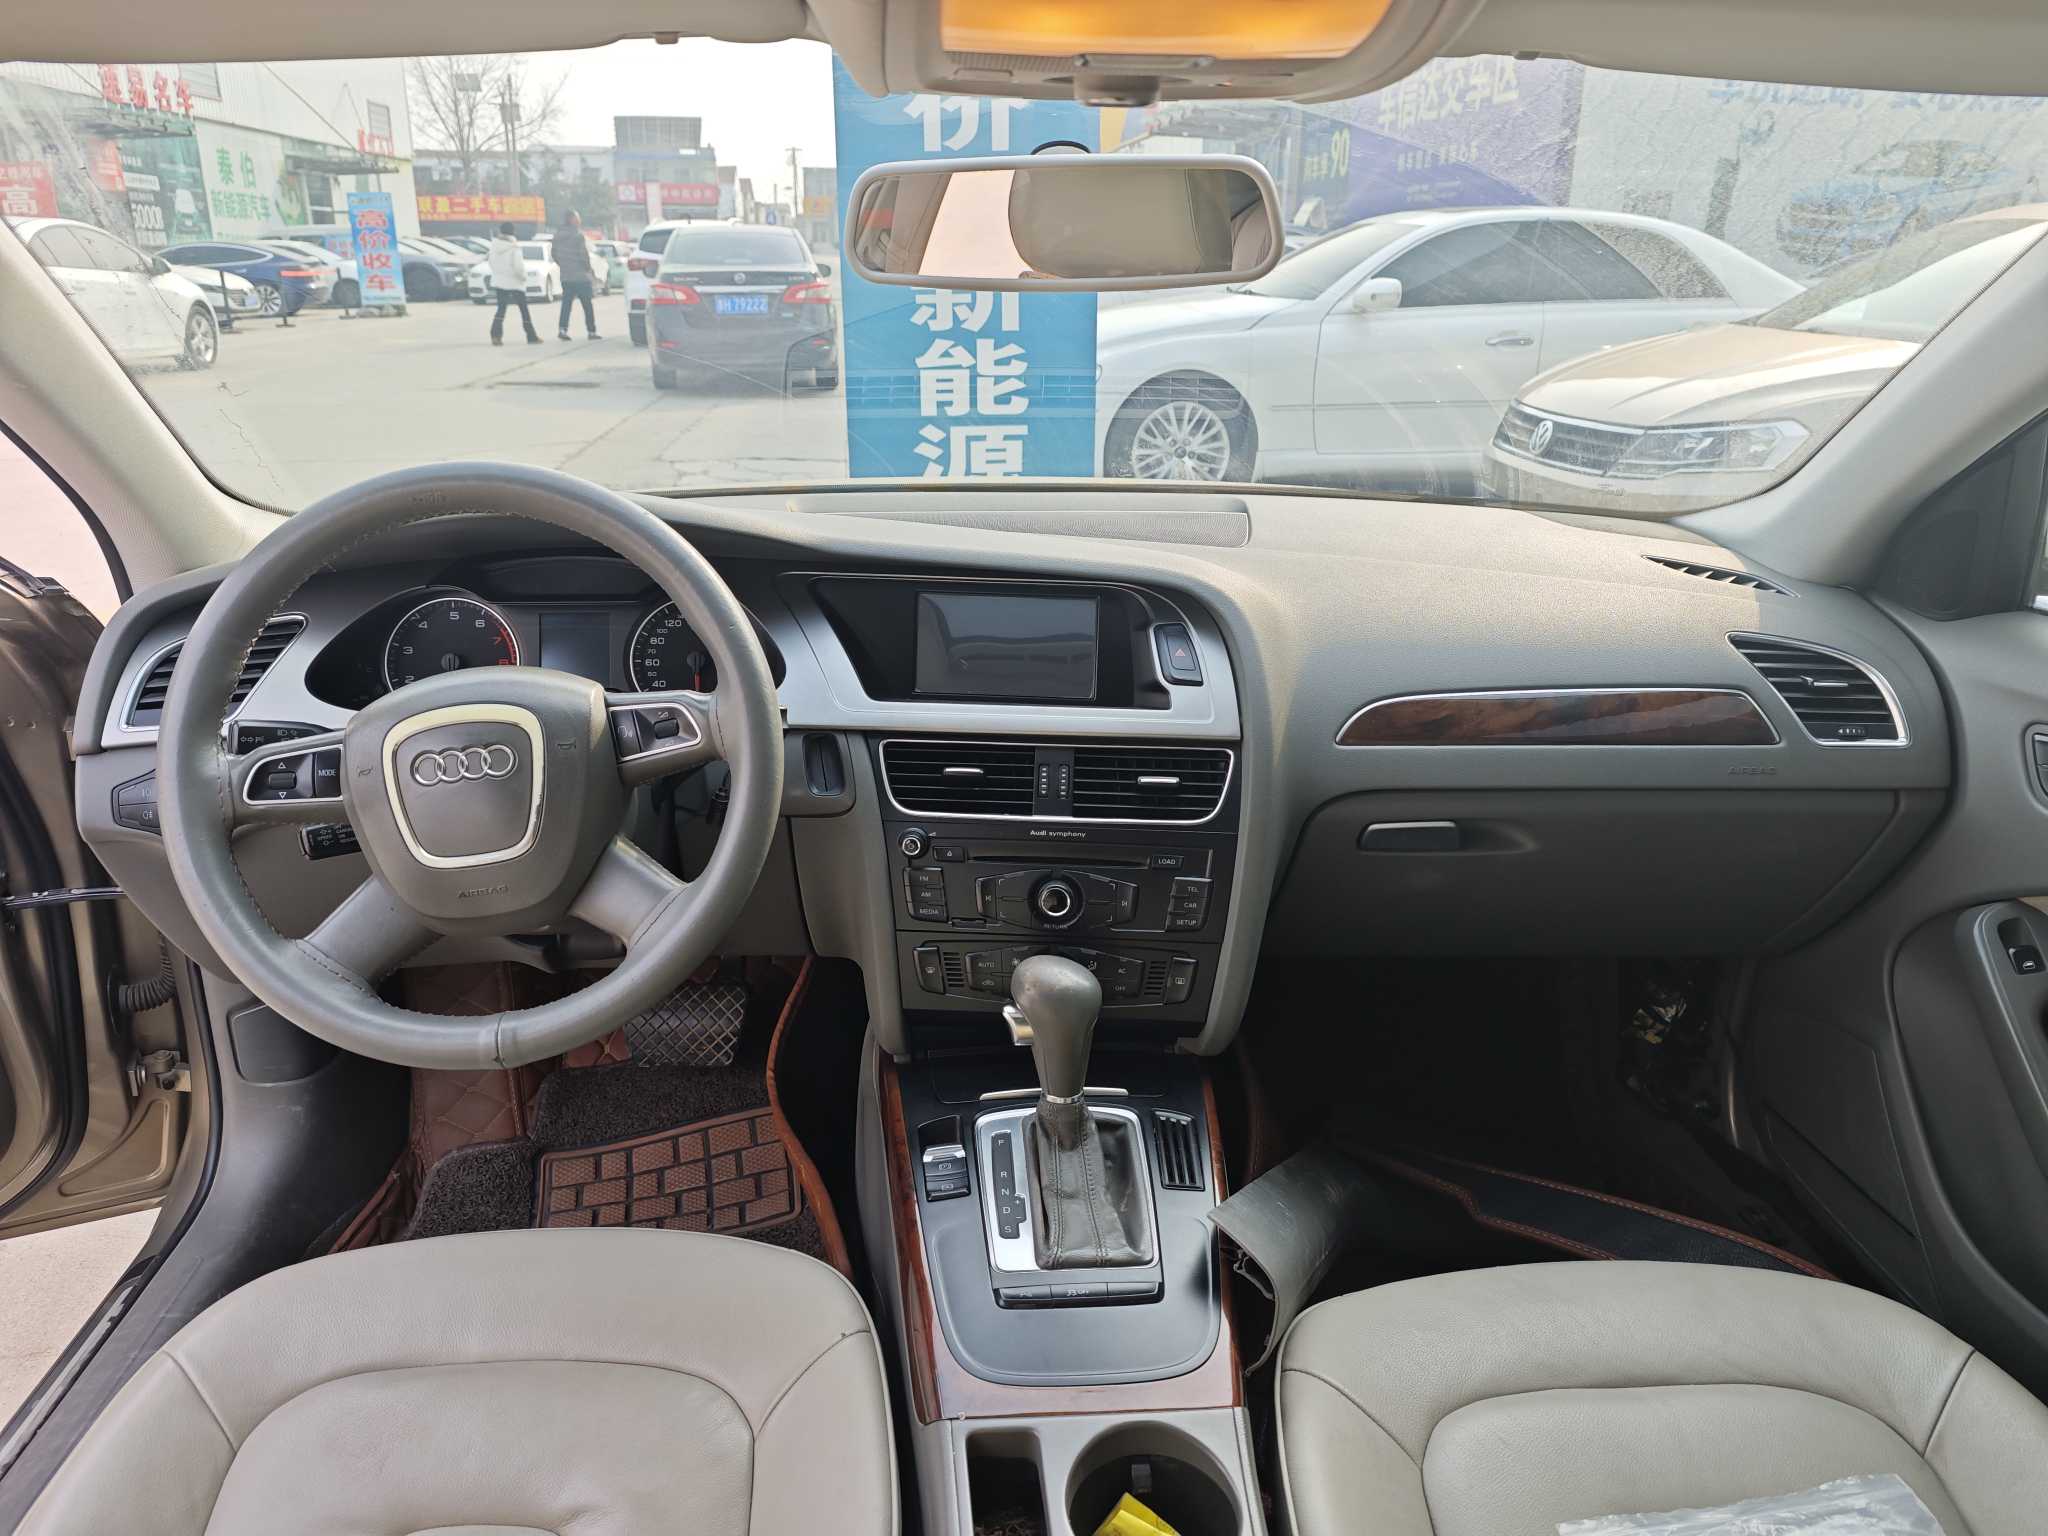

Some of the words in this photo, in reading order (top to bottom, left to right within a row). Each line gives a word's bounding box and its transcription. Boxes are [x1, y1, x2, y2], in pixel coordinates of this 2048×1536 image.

[449, 611, 460, 620] 5
[419, 620, 428, 629] 4
[475, 619, 486, 628] 6
[664, 619, 682, 627] 120
[649, 637, 665, 645] 80
[402, 646, 414, 655] 3
[645, 658, 660, 666] 60
[652, 680, 666, 688] 40
[318, 768, 337, 777] MODE
[1030, 829, 1047, 837] Audi
[1048, 830, 1086, 839] symphony
[1000, 1170, 1008, 1178] R
[1001, 1188, 1010, 1196] N
[1002, 1206, 1011, 1214] D
[1004, 1225, 1012, 1233] S
